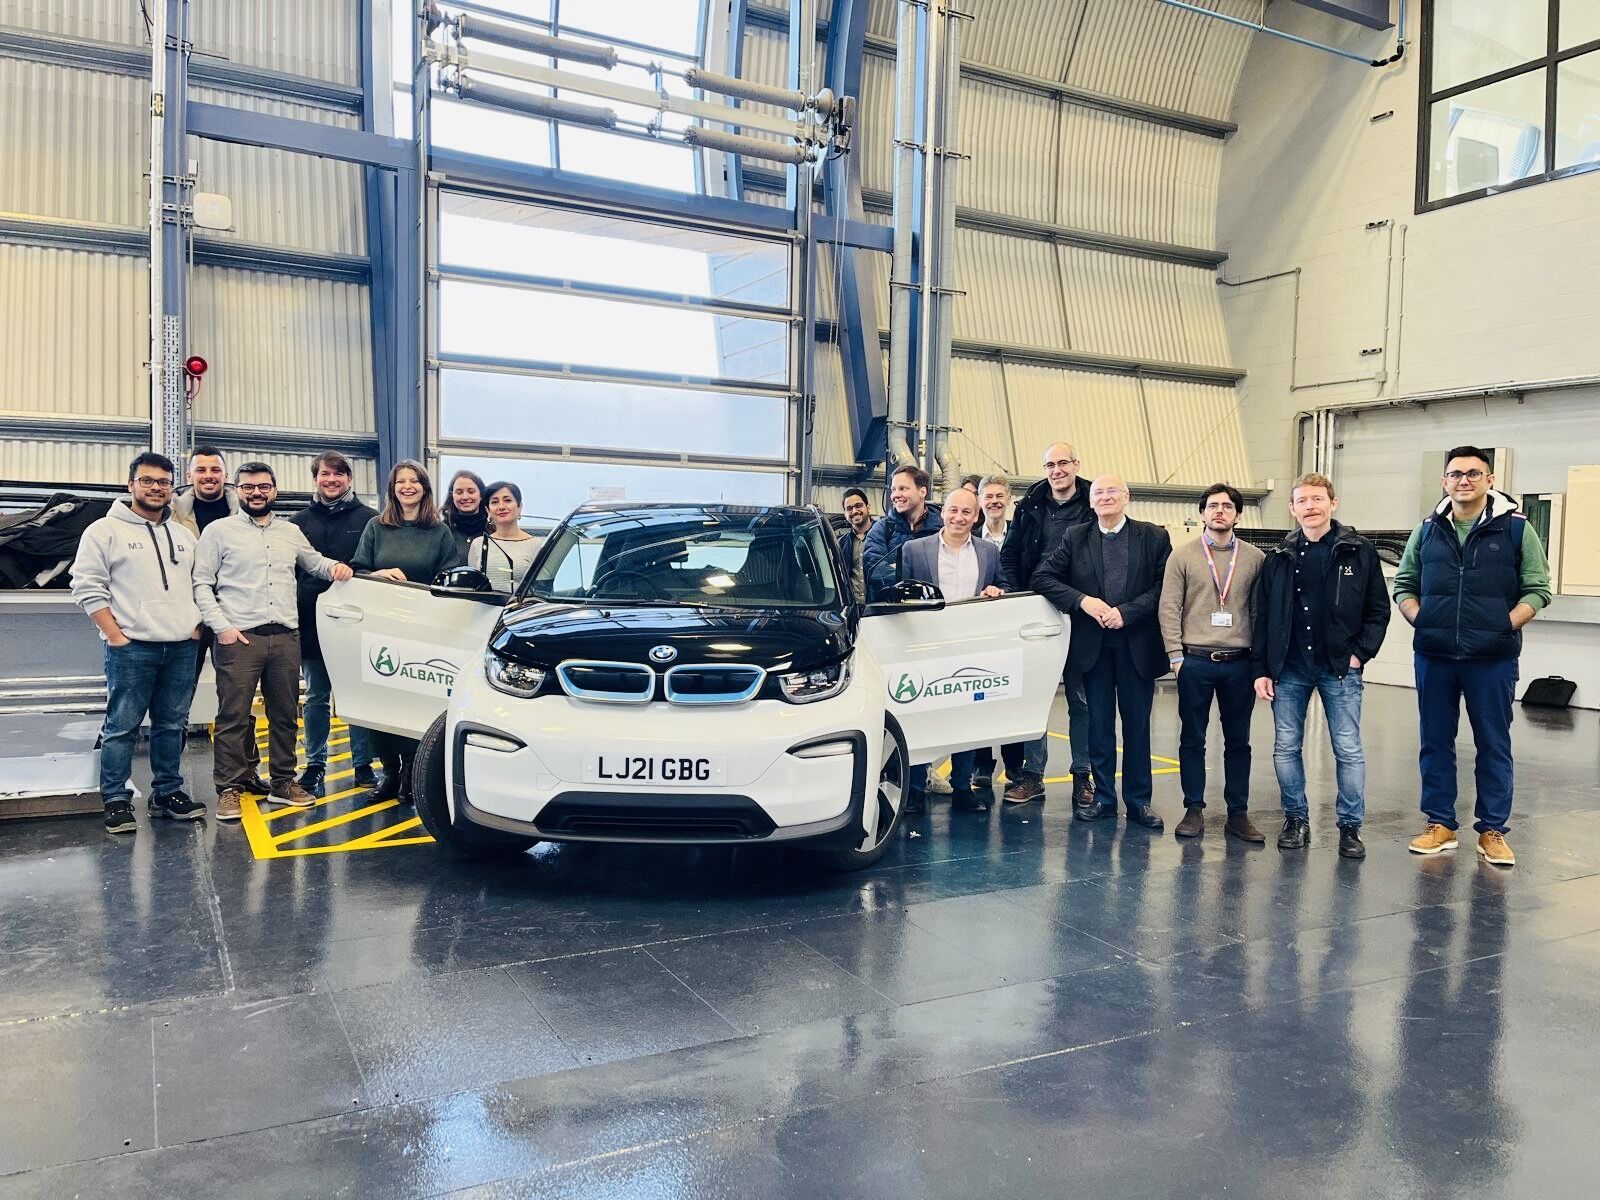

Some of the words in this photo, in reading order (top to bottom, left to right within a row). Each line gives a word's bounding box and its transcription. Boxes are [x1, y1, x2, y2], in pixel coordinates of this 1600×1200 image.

[128, 542, 144, 550] M3
[400, 666, 454, 686] ALBATR
[923, 675, 1010, 698] ALBATROSS
[598, 756, 654, 780] LJ21
[661, 758, 710, 781] GBG
